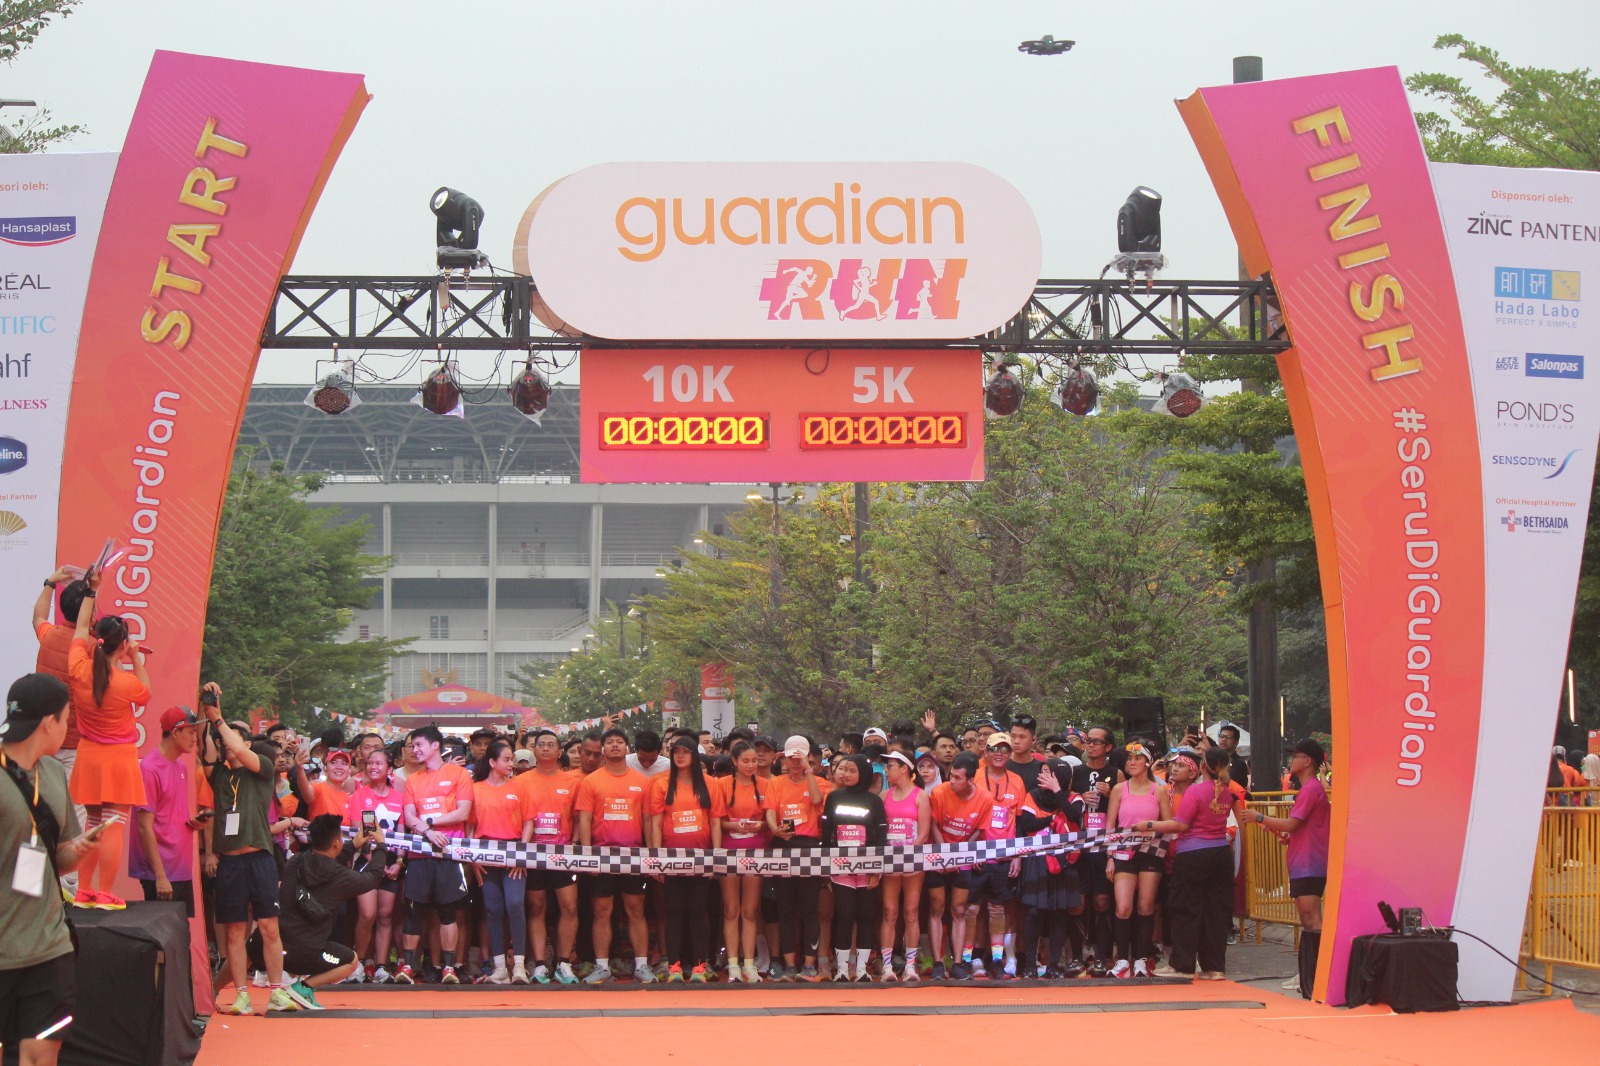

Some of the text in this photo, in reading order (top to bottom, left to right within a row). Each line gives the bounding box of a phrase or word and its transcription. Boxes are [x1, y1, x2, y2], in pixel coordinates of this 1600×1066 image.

[22, 181, 49, 191] oleh:
[1491, 190, 1573, 204] Disponsori oleh:
[2, 222, 72, 235] Hansaplast
[615, 182, 965, 262] guardian
[1520, 221, 1600, 242] PANTEN
[140, 115, 249, 352] START
[1292, 105, 1423, 382] FINISH
[0, 272, 52, 291] ÉAL
[758, 258, 968, 322] RUN
[1495, 300, 1580, 319] Hada Labo
[1496, 317, 1536, 327] PERFECT
[1546, 320, 1577, 329] SIMPLE
[1530, 357, 1580, 374] Salonpas
[641, 364, 735, 404] 10K
[852, 366, 915, 404] 5K
[1497, 400, 1575, 423] POND'S
[604, 416, 764, 445] 00:00:00
[804, 415, 963, 444] 00:00:00
[1492, 455, 1557, 467] SENSODYNE
[1495, 497, 1577, 508] Official Hospital Partner
[1523, 515, 1569, 529] BETHSAIDA
[1393, 407, 1441, 788] #SeruDiGuardian
